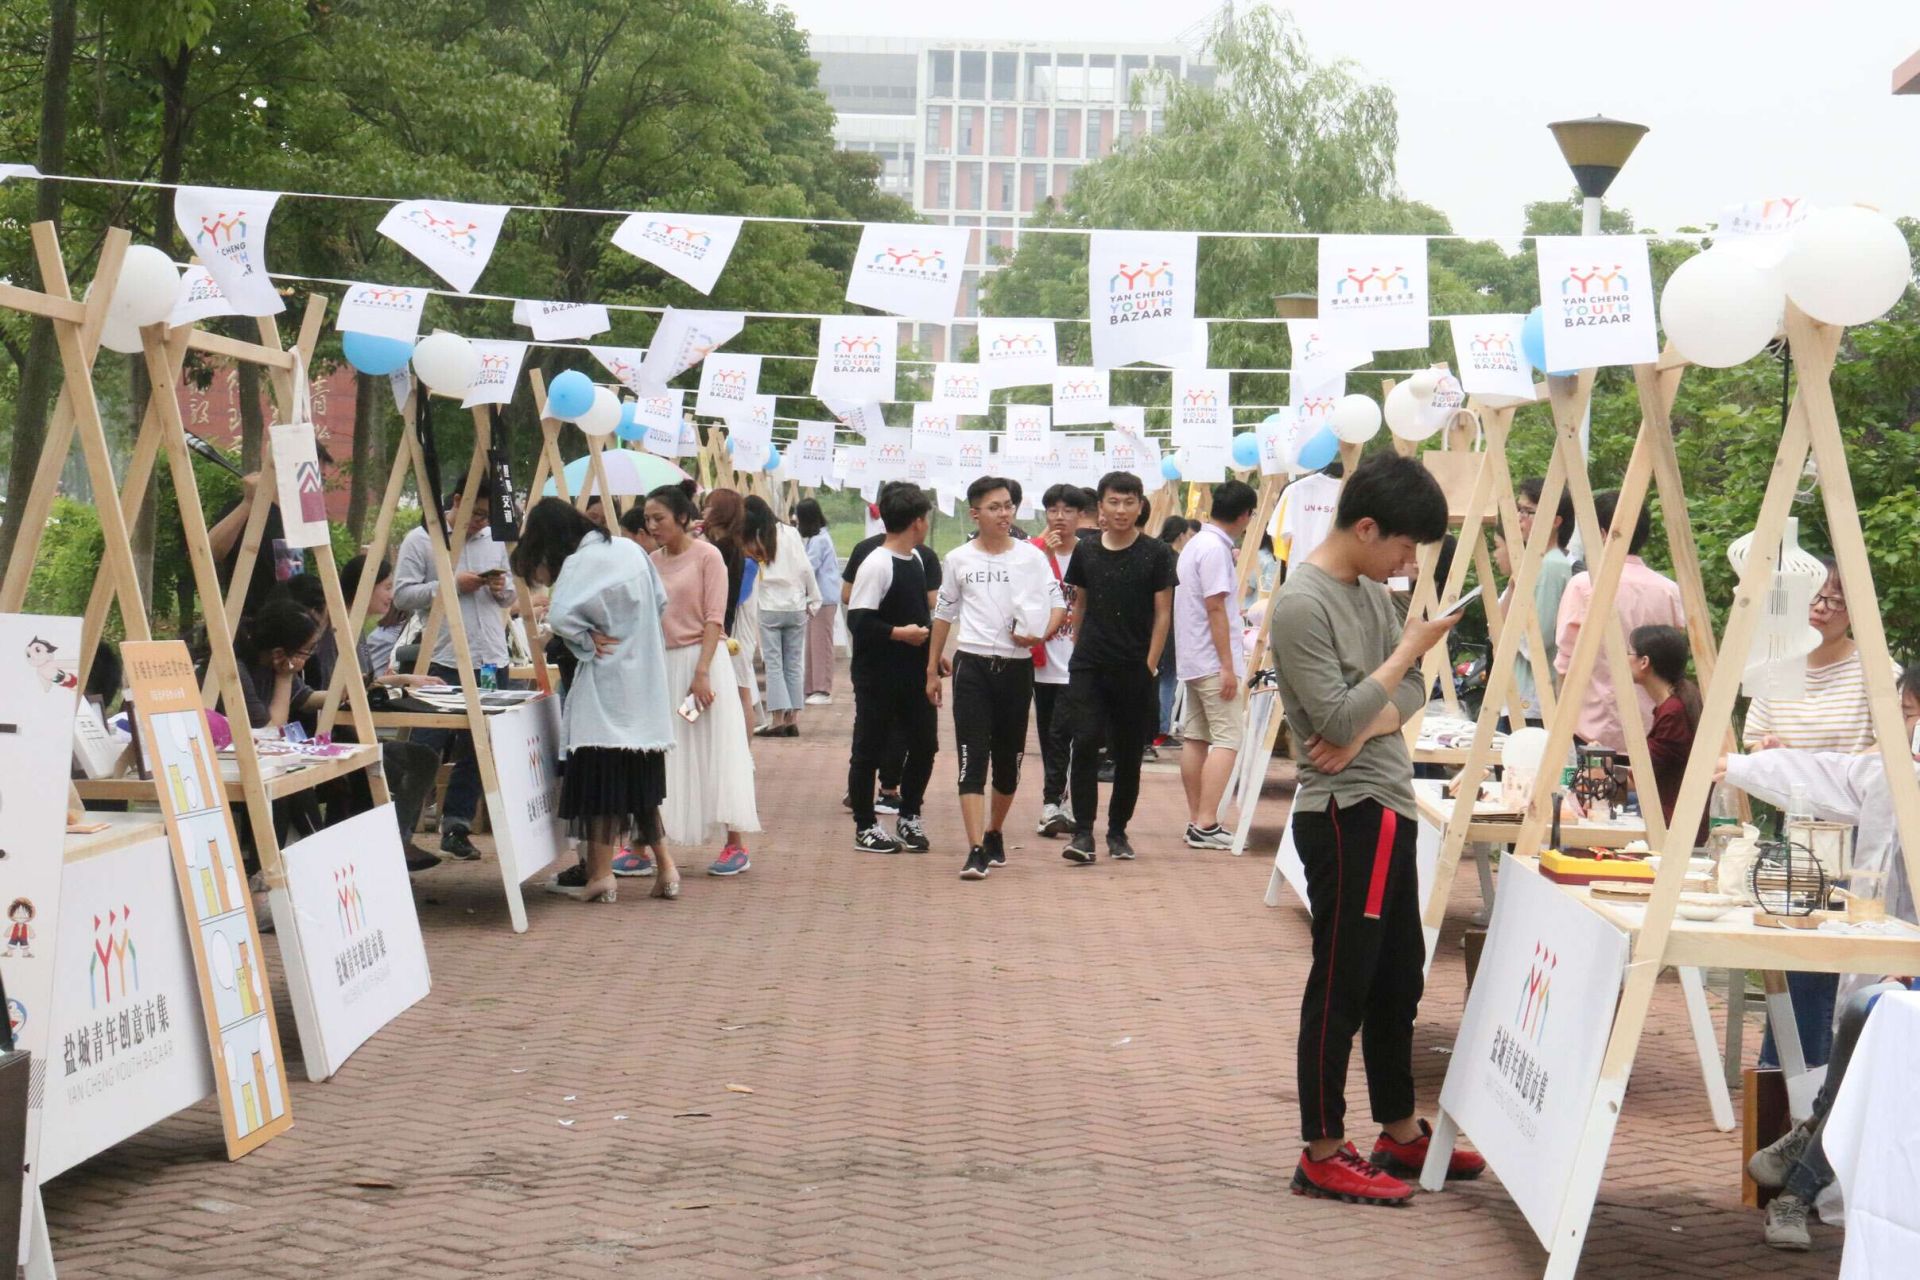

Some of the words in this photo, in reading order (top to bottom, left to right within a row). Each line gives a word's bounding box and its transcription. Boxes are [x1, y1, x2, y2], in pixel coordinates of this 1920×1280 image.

[1110, 294, 1132, 303] YAN
[1135, 289, 1173, 300] CHENG
[1563, 296, 1586, 305] YAN
[1590, 294, 1630, 304] CHENG
[1110, 297, 1173, 314] YOUTH
[1563, 303, 1631, 317] YOUTH
[1110, 308, 1173, 325] BAZAAR
[1564, 313, 1632, 328] BAZAAR
[833, 365, 881, 373] BAZAAR
[834, 359, 880, 367] YOUTH
[1474, 363, 1519, 372] BAZAAR
[709, 391, 744, 401] BAZAAR
[63, 993, 170, 1078] 盐城青年创意市集
